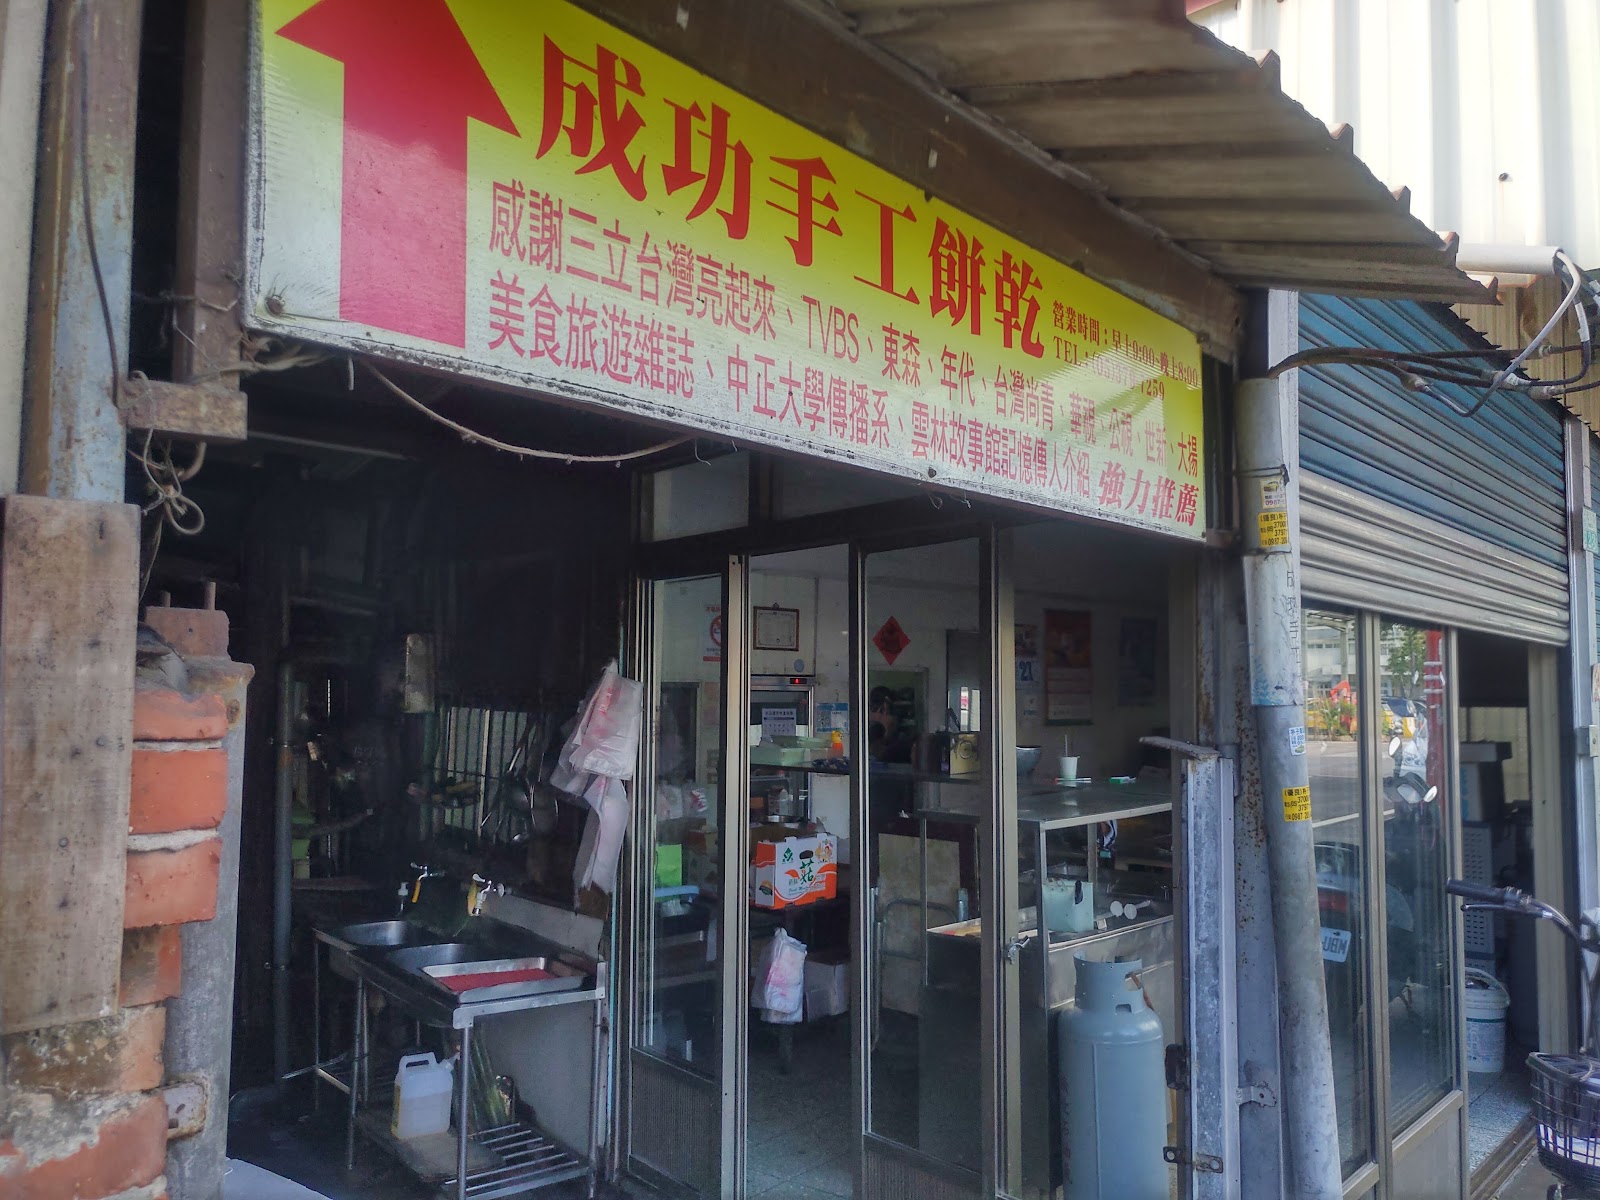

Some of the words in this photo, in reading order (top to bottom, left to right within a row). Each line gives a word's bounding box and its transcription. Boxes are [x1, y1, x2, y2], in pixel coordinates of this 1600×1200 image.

[535, 33, 1046, 358] 成功手工餅乾
[1098, 460, 1200, 527] 強力推薦
